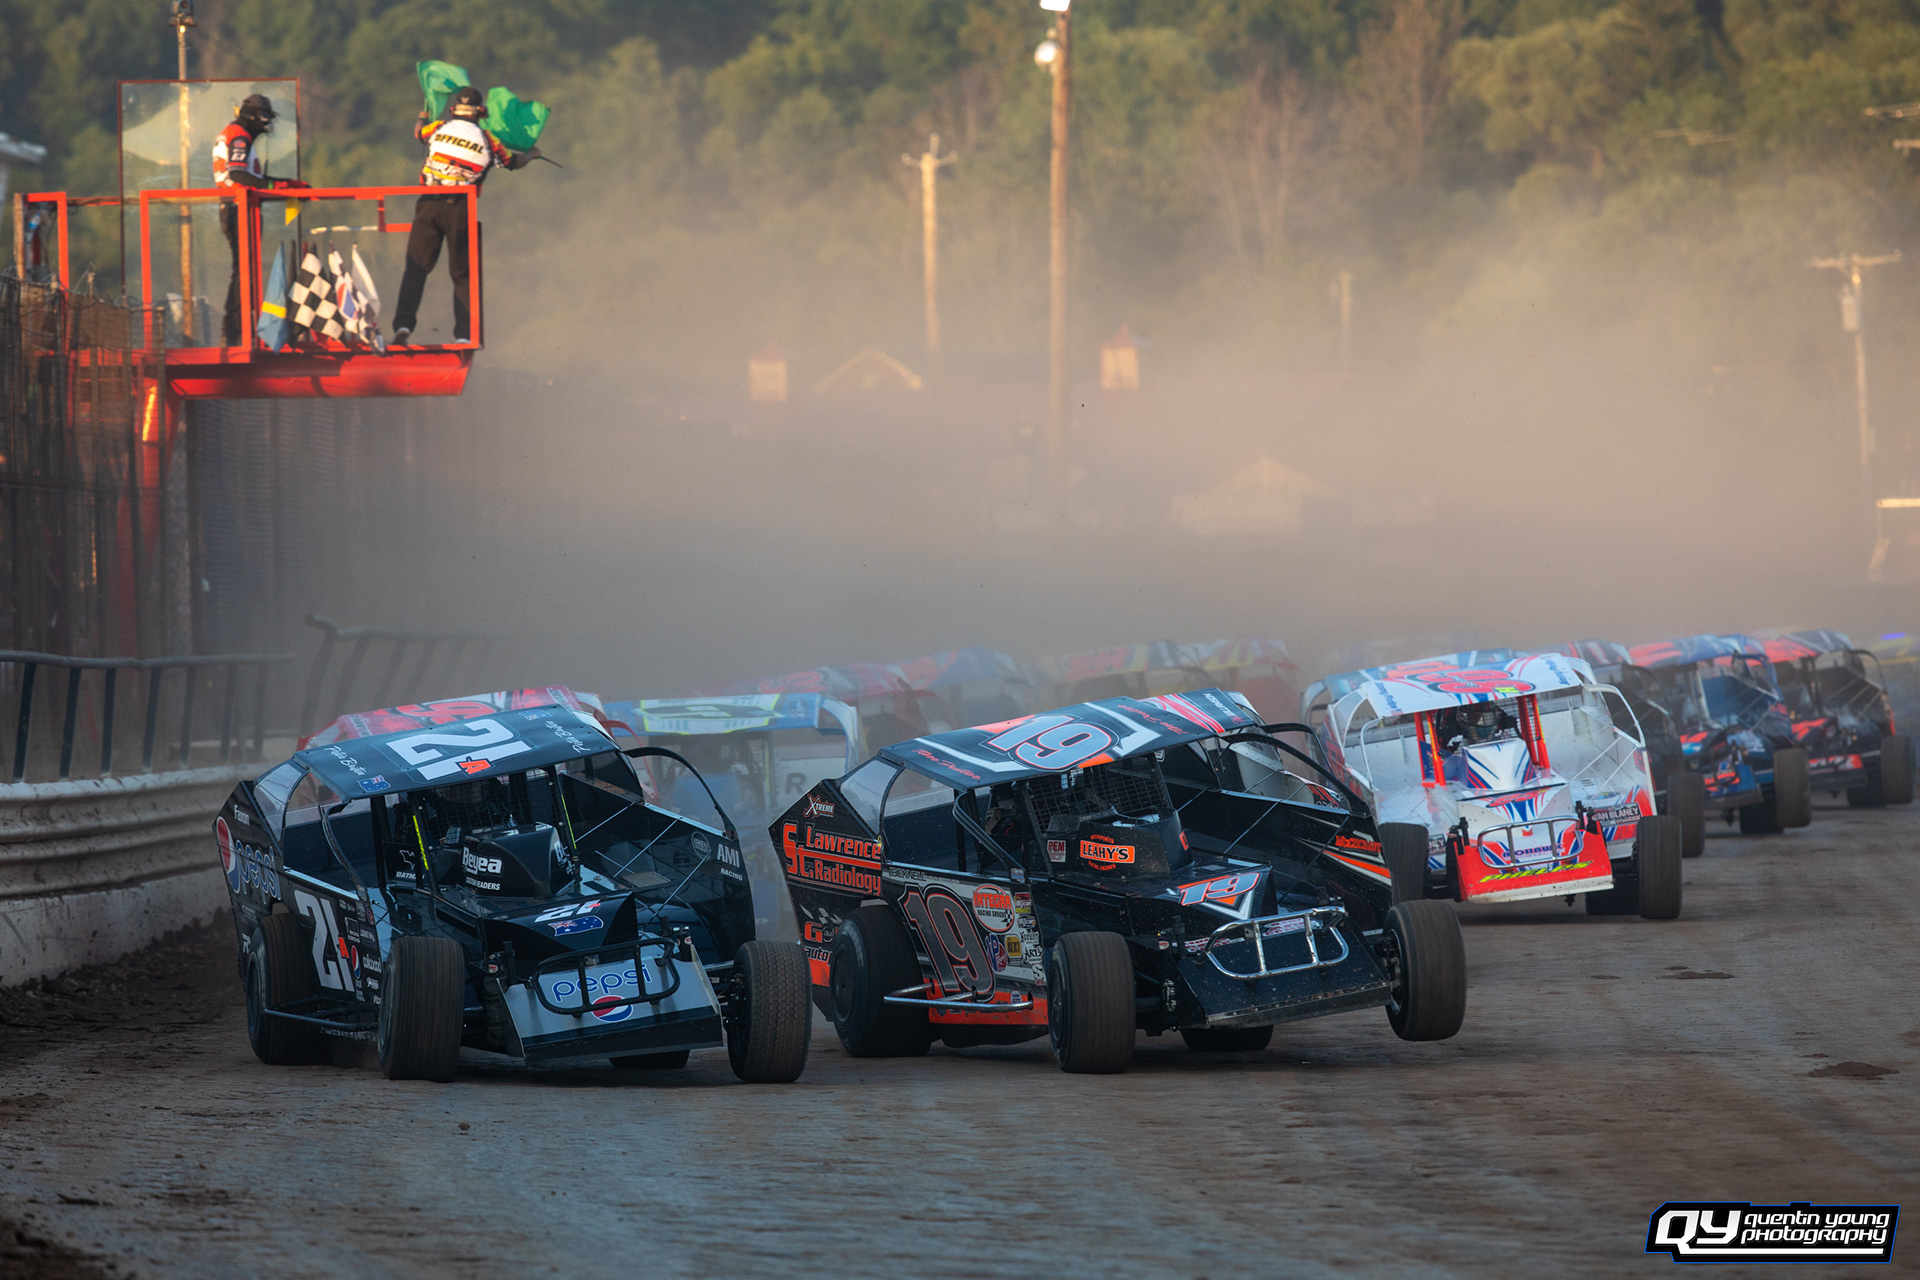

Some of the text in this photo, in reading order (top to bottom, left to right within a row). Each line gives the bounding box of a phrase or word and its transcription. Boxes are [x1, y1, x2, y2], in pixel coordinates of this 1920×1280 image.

[434, 134, 484, 154] OFFICIAL
[386, 719, 534, 781] 21
[983, 714, 1115, 771] 19
[1609, 806, 1639, 819] BLANEY
[716, 843, 741, 869] AMI
[806, 825, 882, 861] Lawrence
[1048, 841, 1065, 852] PEM
[1082, 843, 1130, 861] LEAHY'S
[234, 839, 282, 906] pepsi
[461, 846, 503, 876] Beyea
[720, 867, 744, 881] RACING
[814, 859, 882, 897] Radiology
[973, 892, 1012, 910] INTEGRA
[1179, 872, 1260, 906] 19
[294, 889, 356, 993] 21
[899, 885, 996, 1003] 19
[552, 962, 653, 1003] pepsi
